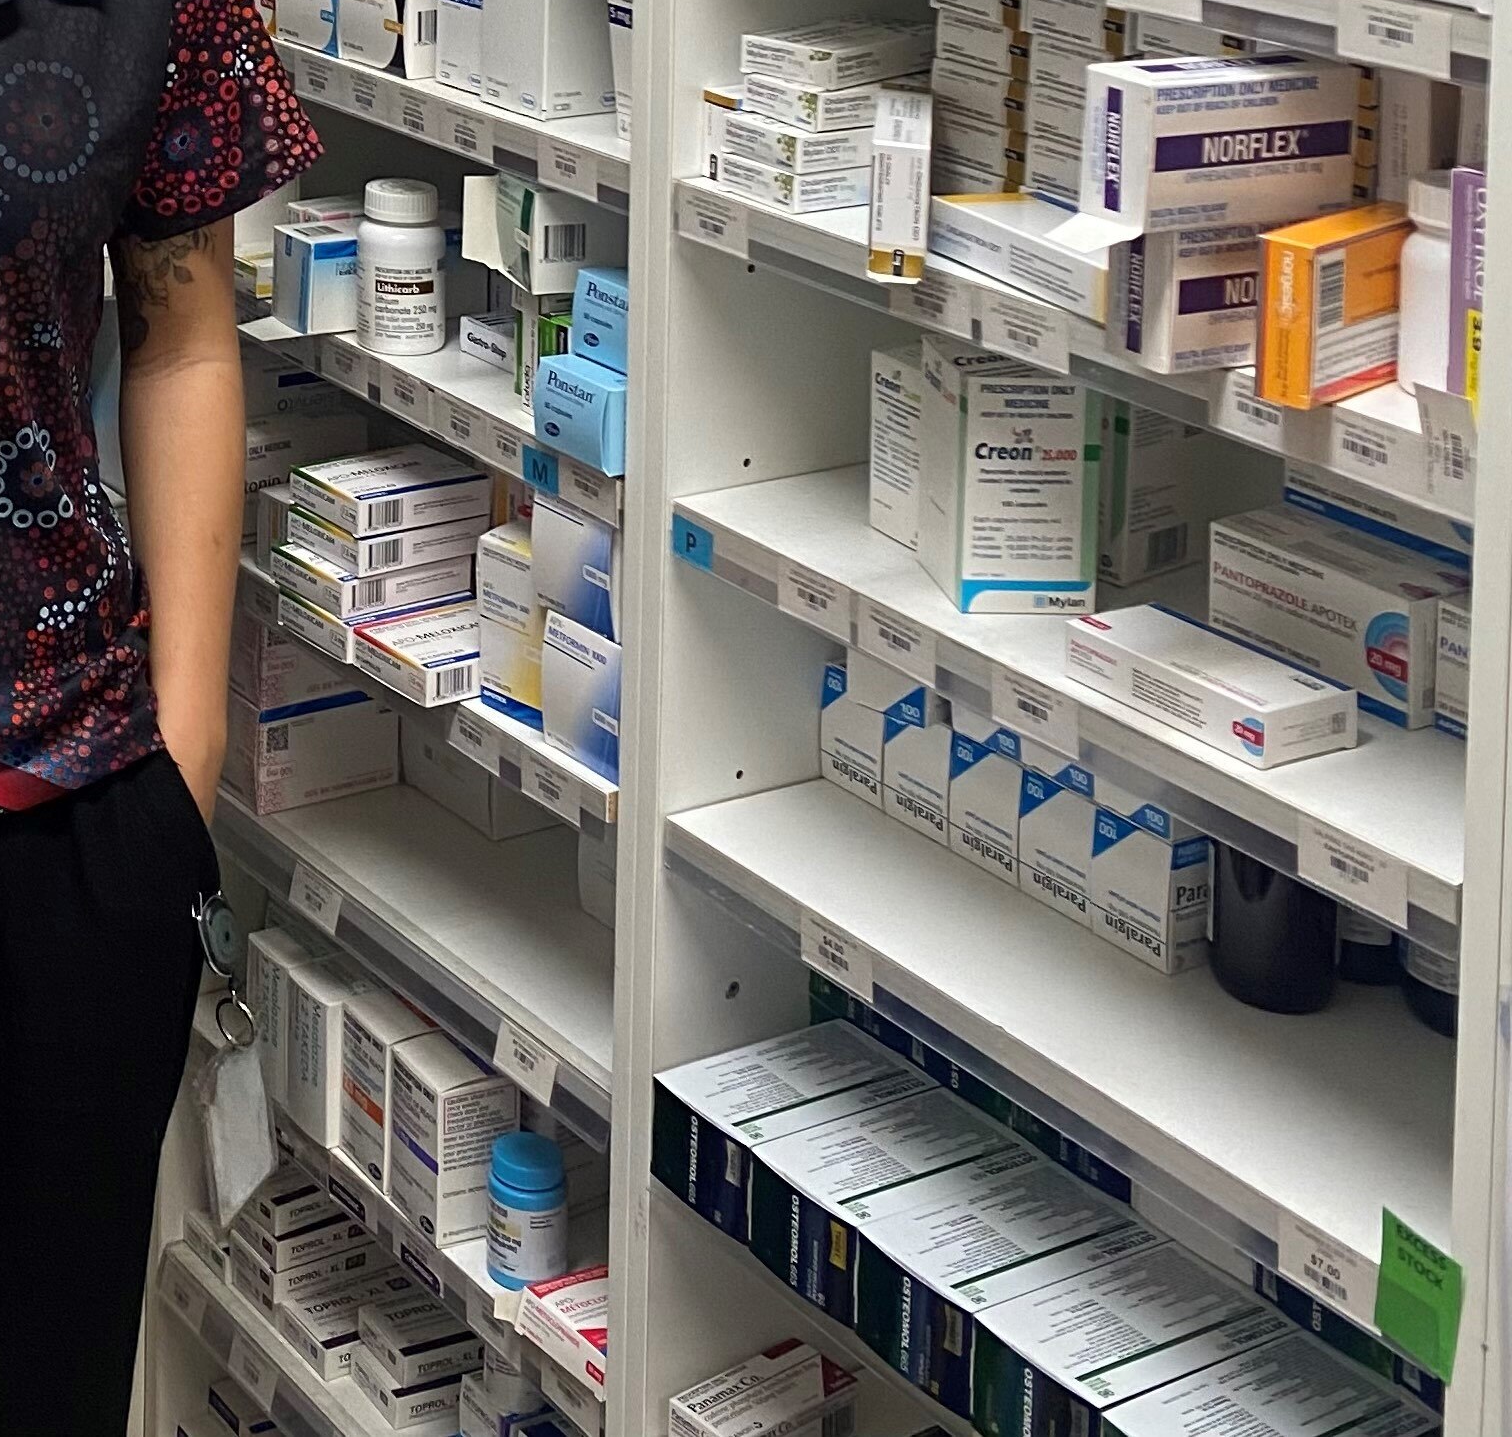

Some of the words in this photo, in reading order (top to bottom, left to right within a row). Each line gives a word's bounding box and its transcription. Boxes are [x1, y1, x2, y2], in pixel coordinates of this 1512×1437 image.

[1105, 111, 1122, 185] NORFLEX
[1201, 131, 1302, 165] NORFLEX
[376, 282, 420, 295] Lithicarb
[1126, 252, 1143, 324] NORFLEX
[546, 369, 596, 404] Ponstan
[532, 457, 549, 483] M
[973, 441, 1034, 463] Creon
[684, 530, 698, 553] P
[1047, 595, 1086, 610] Mylan
[1212, 561, 1309, 612] PANTOPRAZOLE
[1309, 602, 1359, 633] APOTEX
[832, 759, 879, 796] Paralgin
[895, 792, 945, 832] Paralgin
[961, 832, 1014, 873] Paralgin
[1032, 871, 1088, 914] Paralgin
[1104, 912, 1163, 958] Paralgin
[689, 1114, 699, 1184] OSTEOMOL
[790, 1193, 800, 1263] OSTEOMOL
[1395, 1223, 1449, 1272] EXCESS
[1309, 1252, 1342, 1282] $7.00
[1397, 1246, 1445, 1291] STOCK
[902, 1275, 913, 1346] OSTEOMOL
[686, 1382, 741, 1414] Panamax
